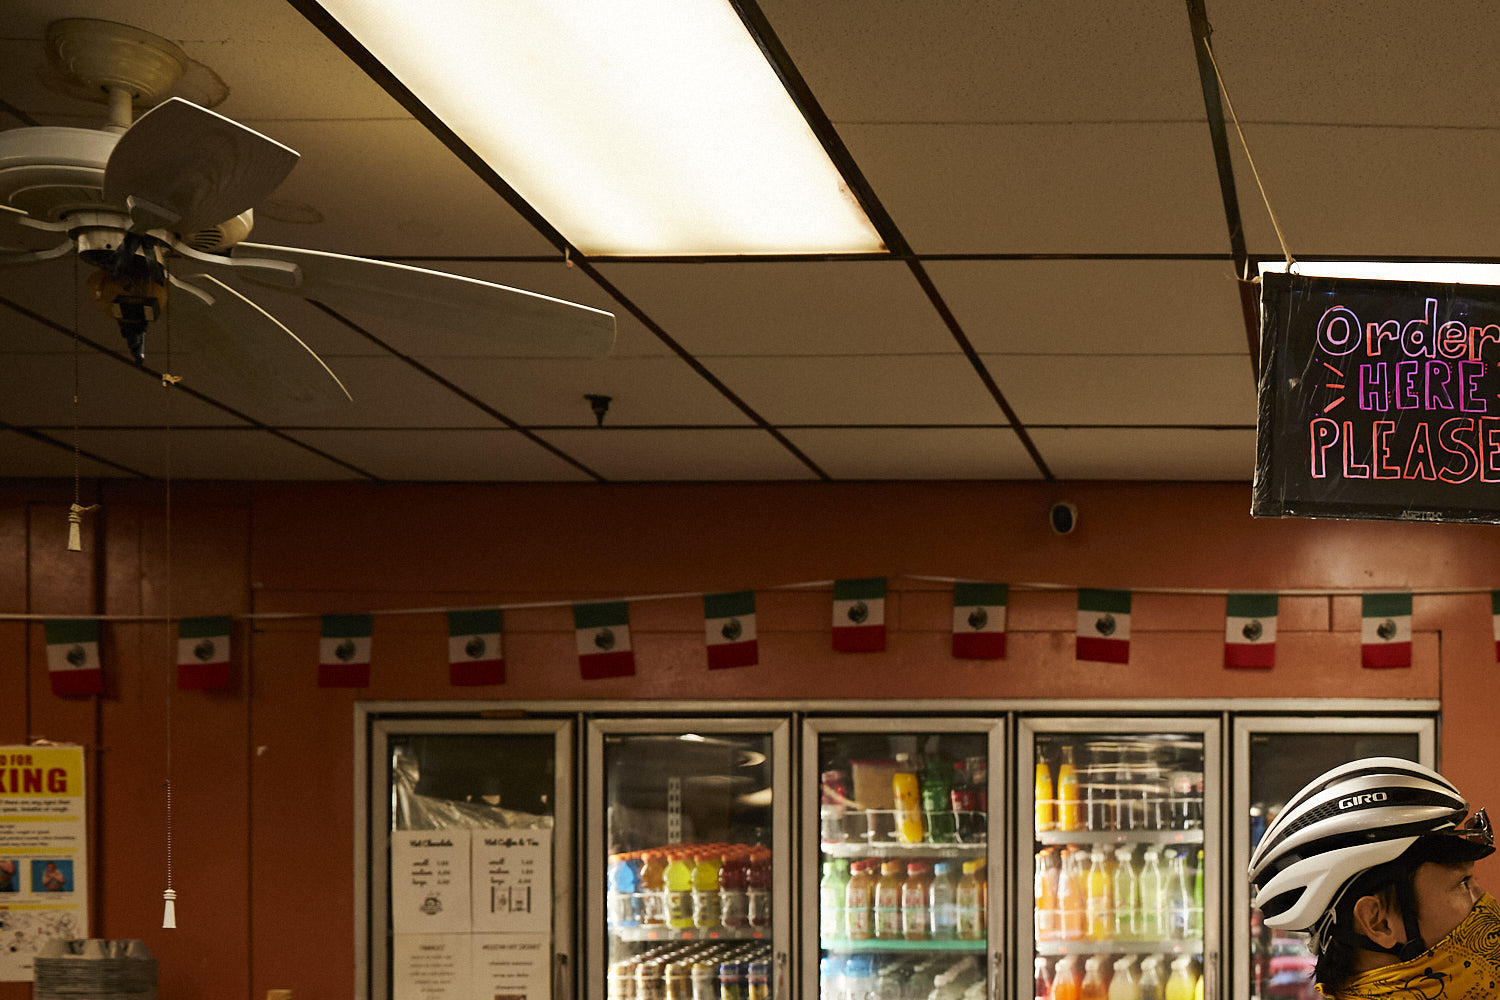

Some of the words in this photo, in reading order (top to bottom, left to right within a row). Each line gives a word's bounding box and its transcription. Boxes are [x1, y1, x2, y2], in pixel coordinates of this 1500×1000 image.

[1358, 359, 1488, 413] HERE
[10, 754, 33, 766] FOR
[1338, 791, 1388, 811] GIRO
